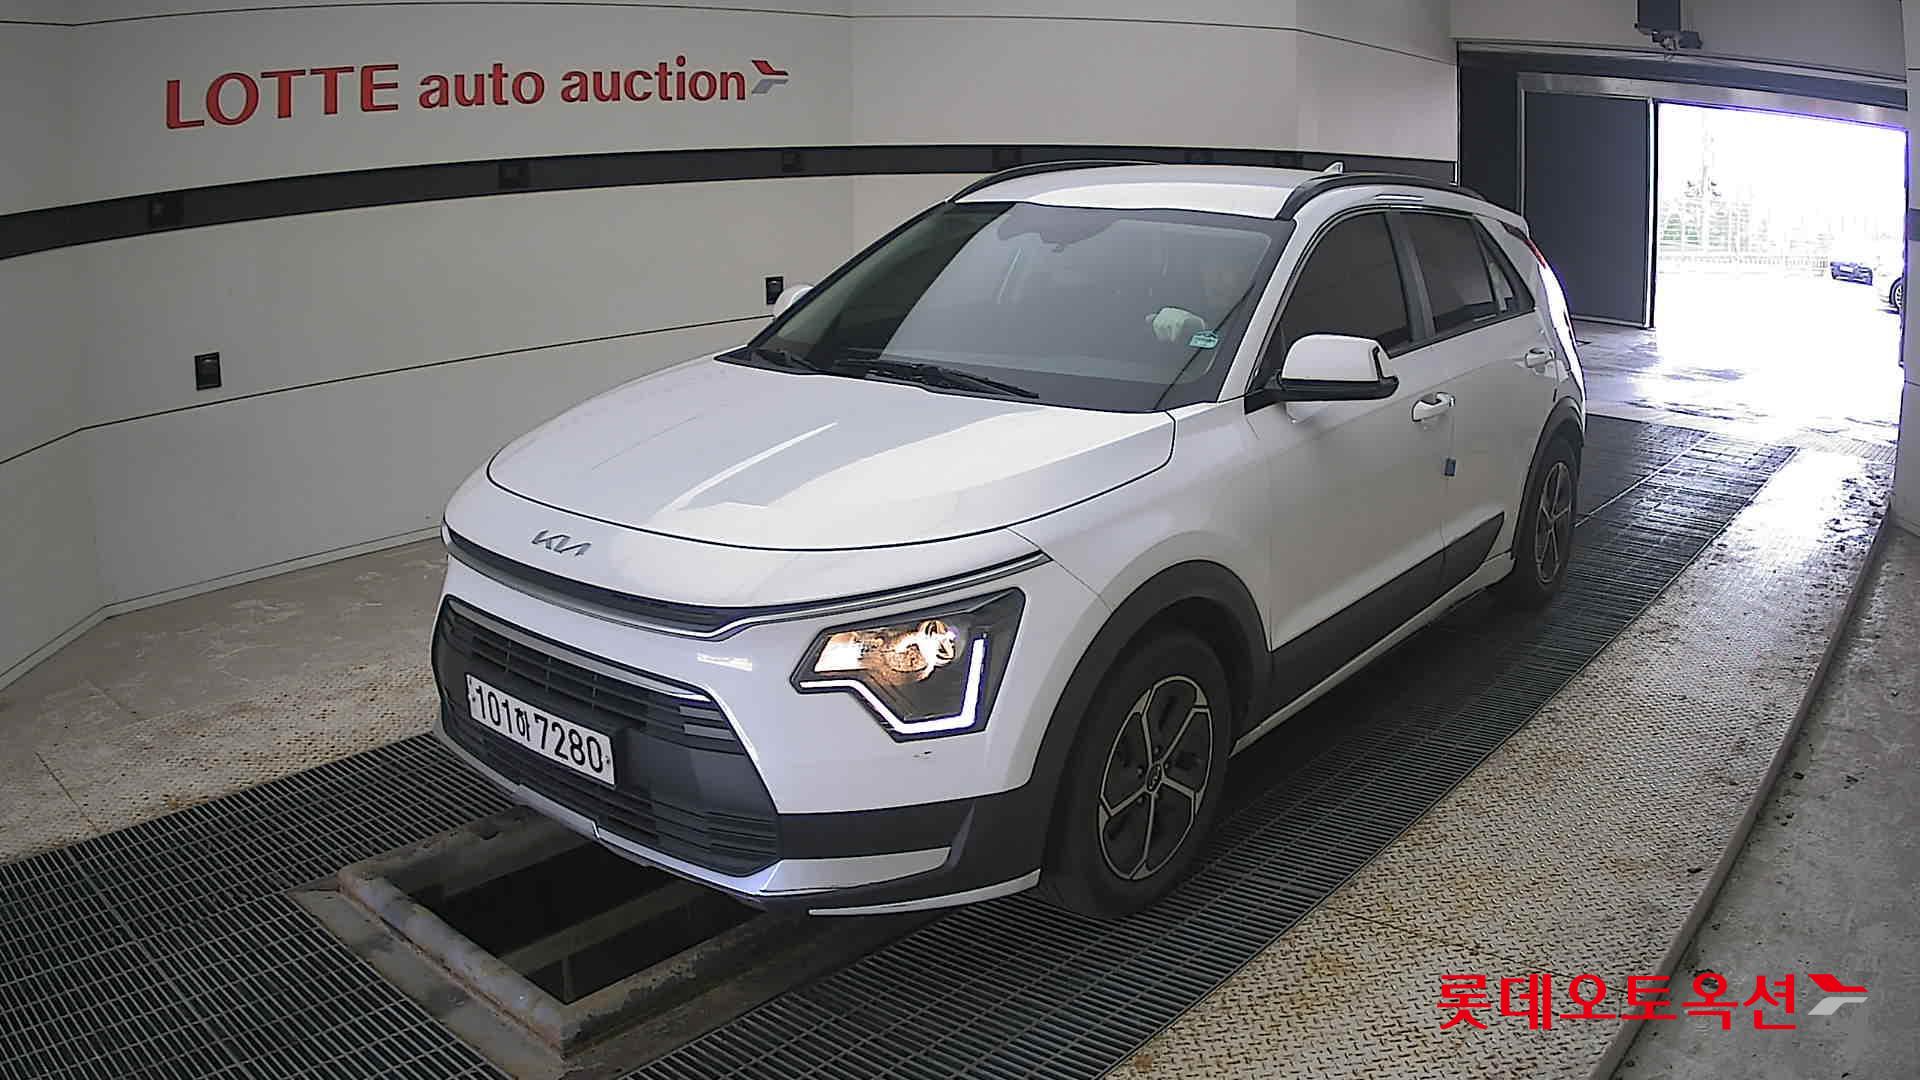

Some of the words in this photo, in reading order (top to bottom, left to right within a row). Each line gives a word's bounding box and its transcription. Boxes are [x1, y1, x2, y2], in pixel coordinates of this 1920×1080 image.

[166, 64, 400, 130] LOTTE
[418, 63, 545, 110] auto
[561, 55, 747, 102] auction
[531, 529, 592, 556] KIA
